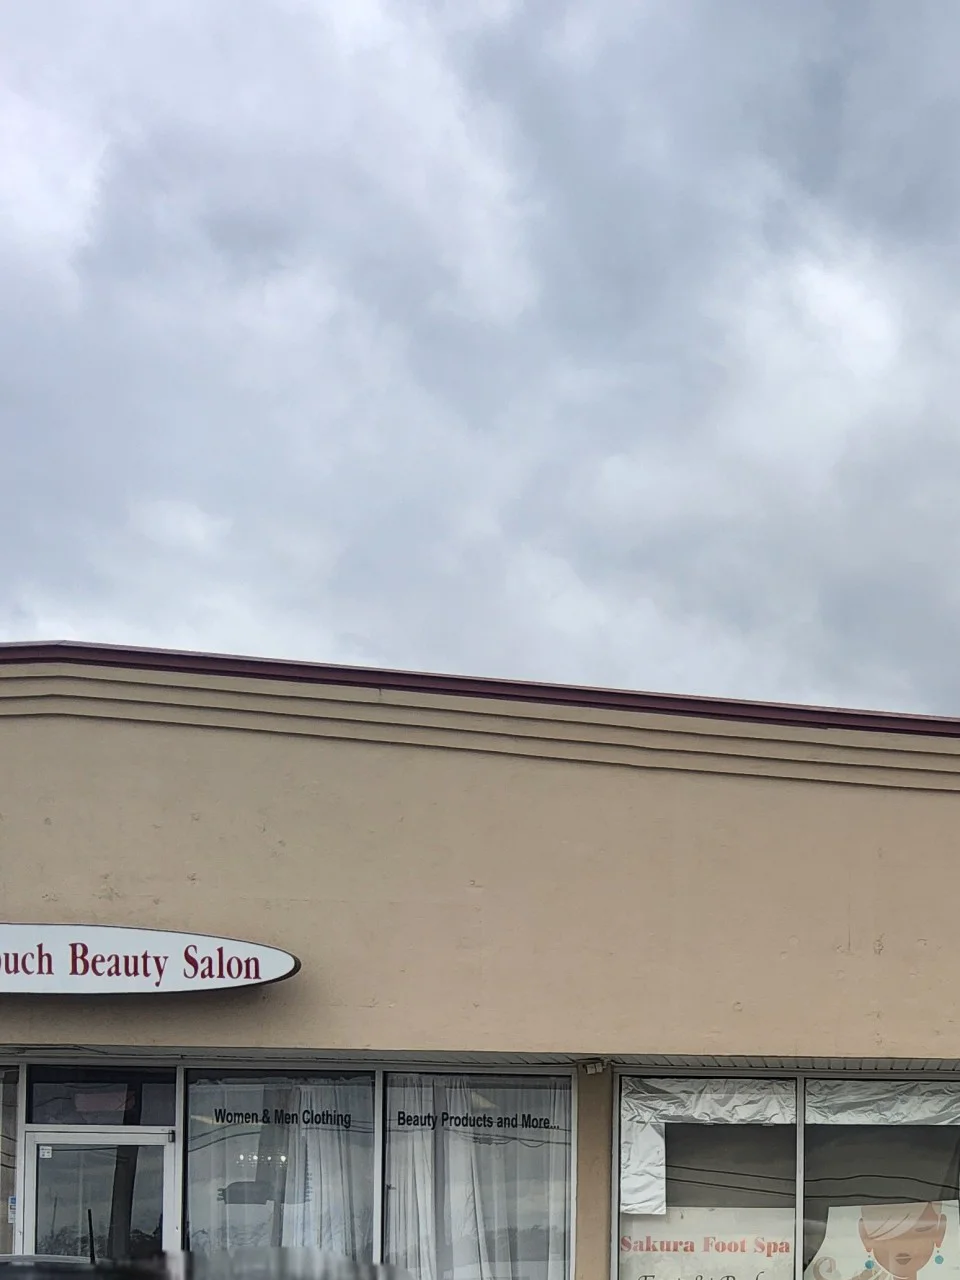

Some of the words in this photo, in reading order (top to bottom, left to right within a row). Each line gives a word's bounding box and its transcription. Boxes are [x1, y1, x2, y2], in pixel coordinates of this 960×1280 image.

[0, 943, 54, 975] uch
[68, 942, 169, 987] Beauty
[182, 944, 262, 980] Salon
[214, 1108, 259, 1124] Women
[262, 1108, 270, 1124] &
[274, 1109, 298, 1124] Men
[302, 1109, 352, 1128] Clothing
[397, 1111, 437, 1130] Beauty
[441, 1112, 493, 1127] Products
[497, 1113, 518, 1128] and
[620, 1235, 695, 1253] Sakura
[701, 1236, 747, 1253] Foot
[753, 1236, 790, 1257] Spa
